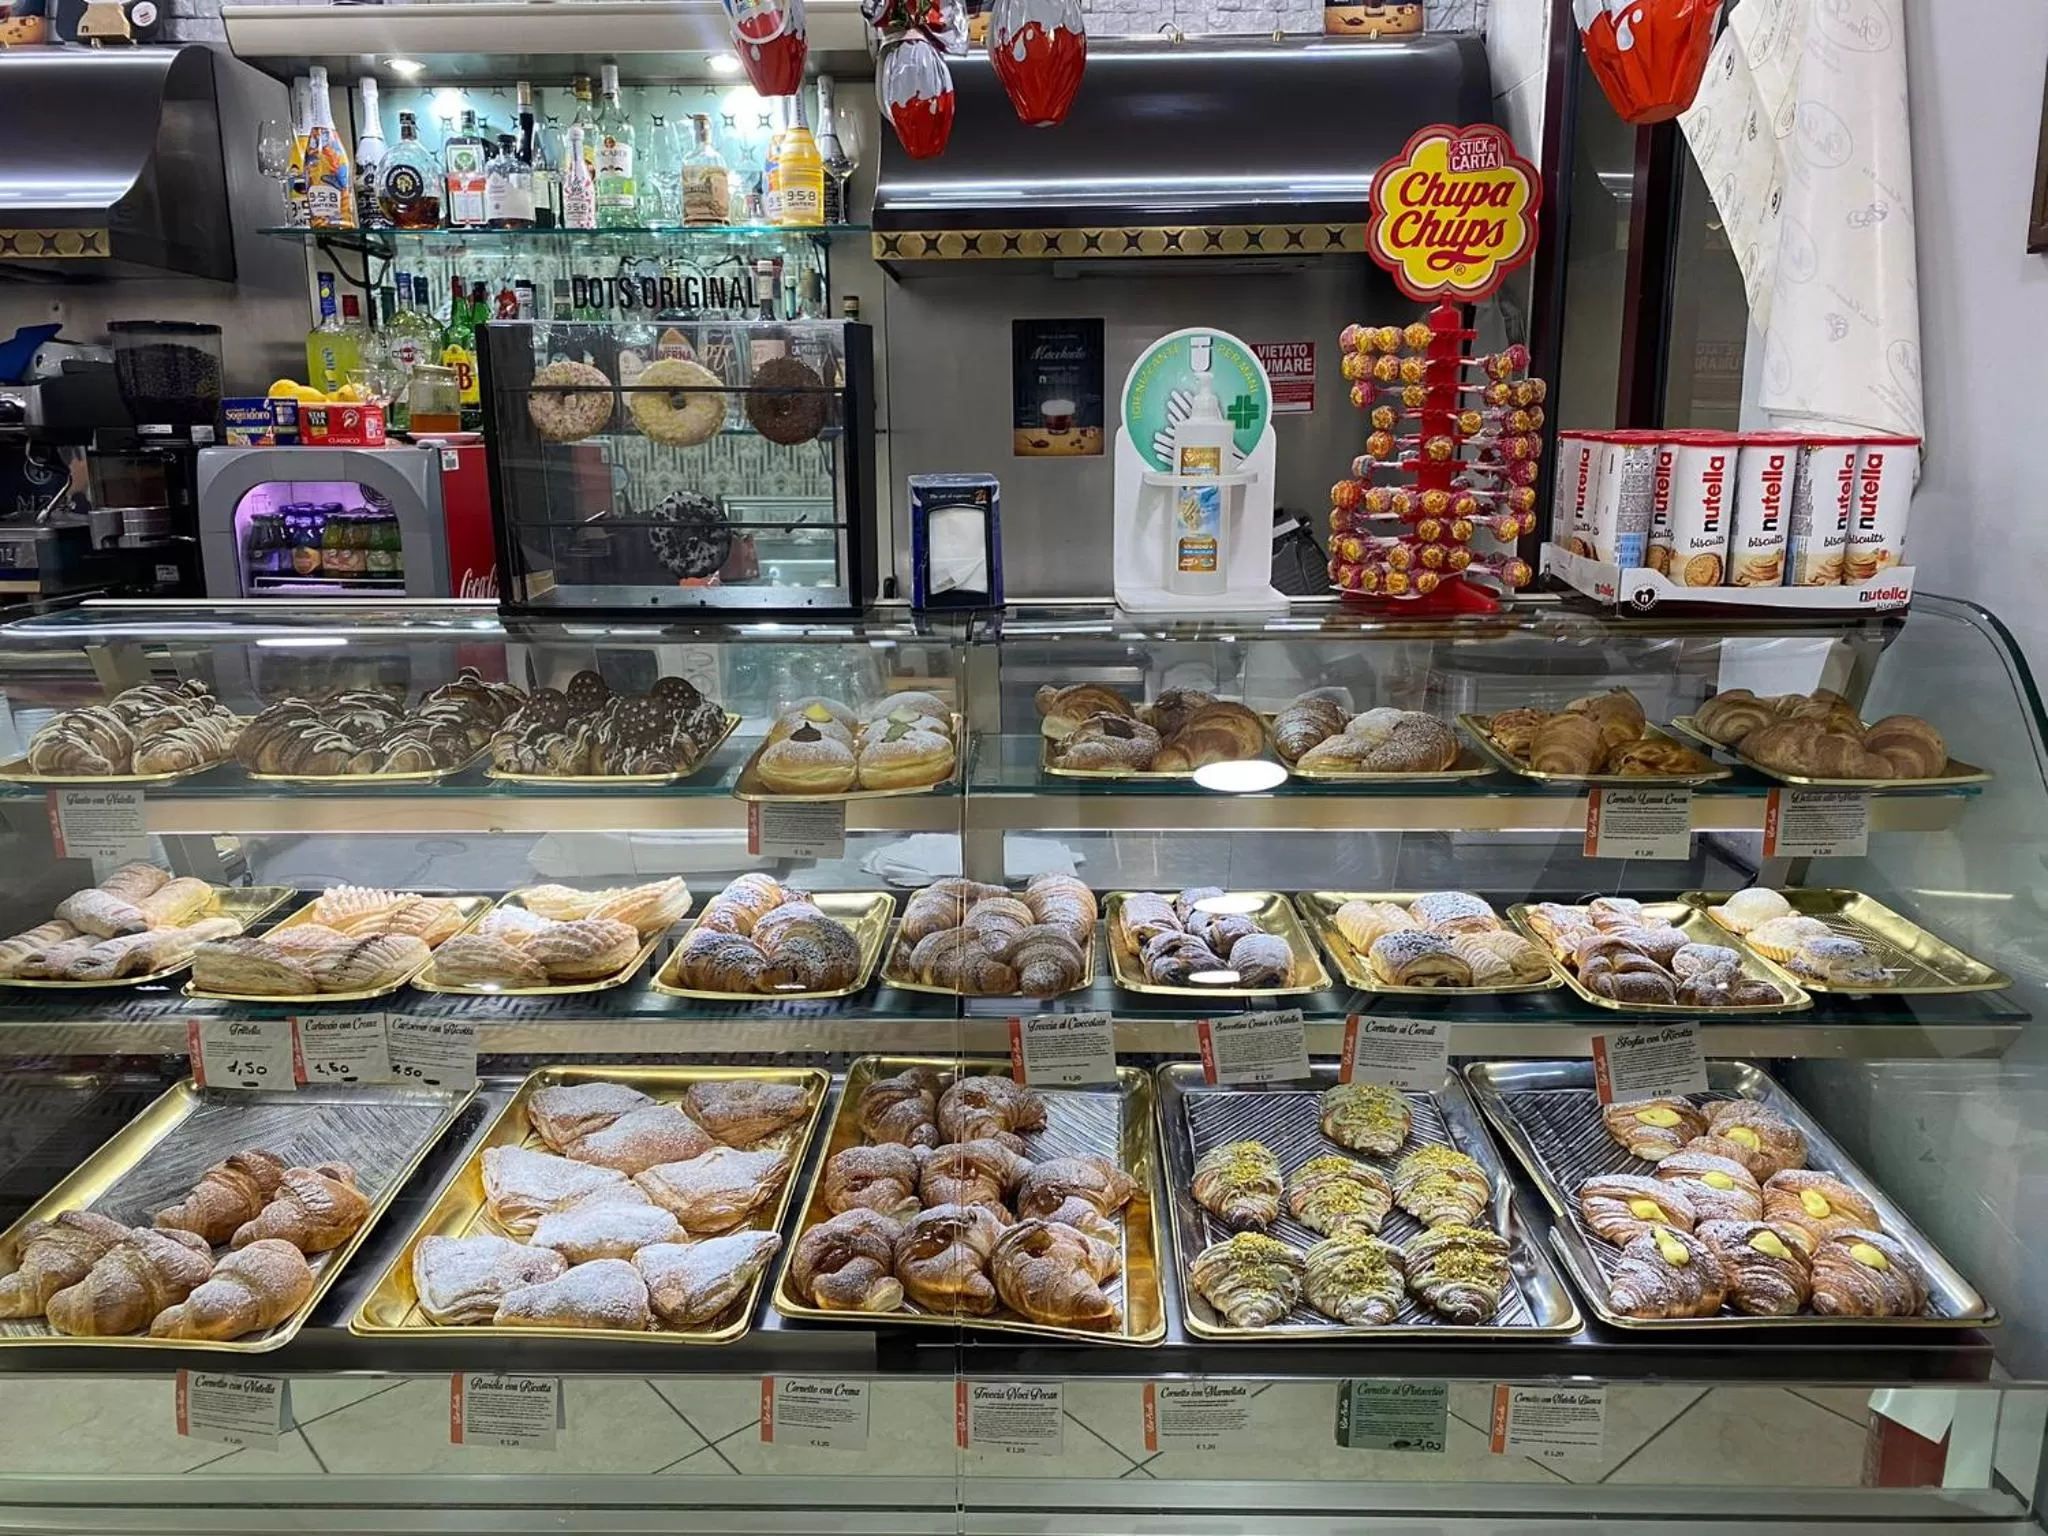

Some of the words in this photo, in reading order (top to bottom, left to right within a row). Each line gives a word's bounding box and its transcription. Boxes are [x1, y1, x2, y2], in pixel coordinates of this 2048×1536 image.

[1459, 140, 1488, 155] STICK
[1452, 153, 1496, 170] CARTA
[1399, 172, 1517, 217] Chupa
[1390, 210, 1507, 270] Chups
[571, 276, 632, 309] DOTS
[641, 276, 761, 309] ORIGINAL
[1257, 344, 1308, 358] VIETATO
[1262, 357, 1313, 373] UMARE
[1575, 448, 1590, 519] nutella
[1654, 452, 1672, 525] nutella
[1702, 455, 1725, 532] nutella
[1761, 455, 1785, 532] nutella
[1837, 454, 1855, 531] nutella
[1859, 454, 1883, 530] nutella
[1690, 535, 1725, 549] biscuits
[1748, 534, 1784, 548] biscuits
[1859, 587, 1909, 602] nutella
[785, 1381, 818, 1393] Cornetto
[834, 1383, 860, 1396] Crema
[974, 1387, 1004, 1399] Treccia
